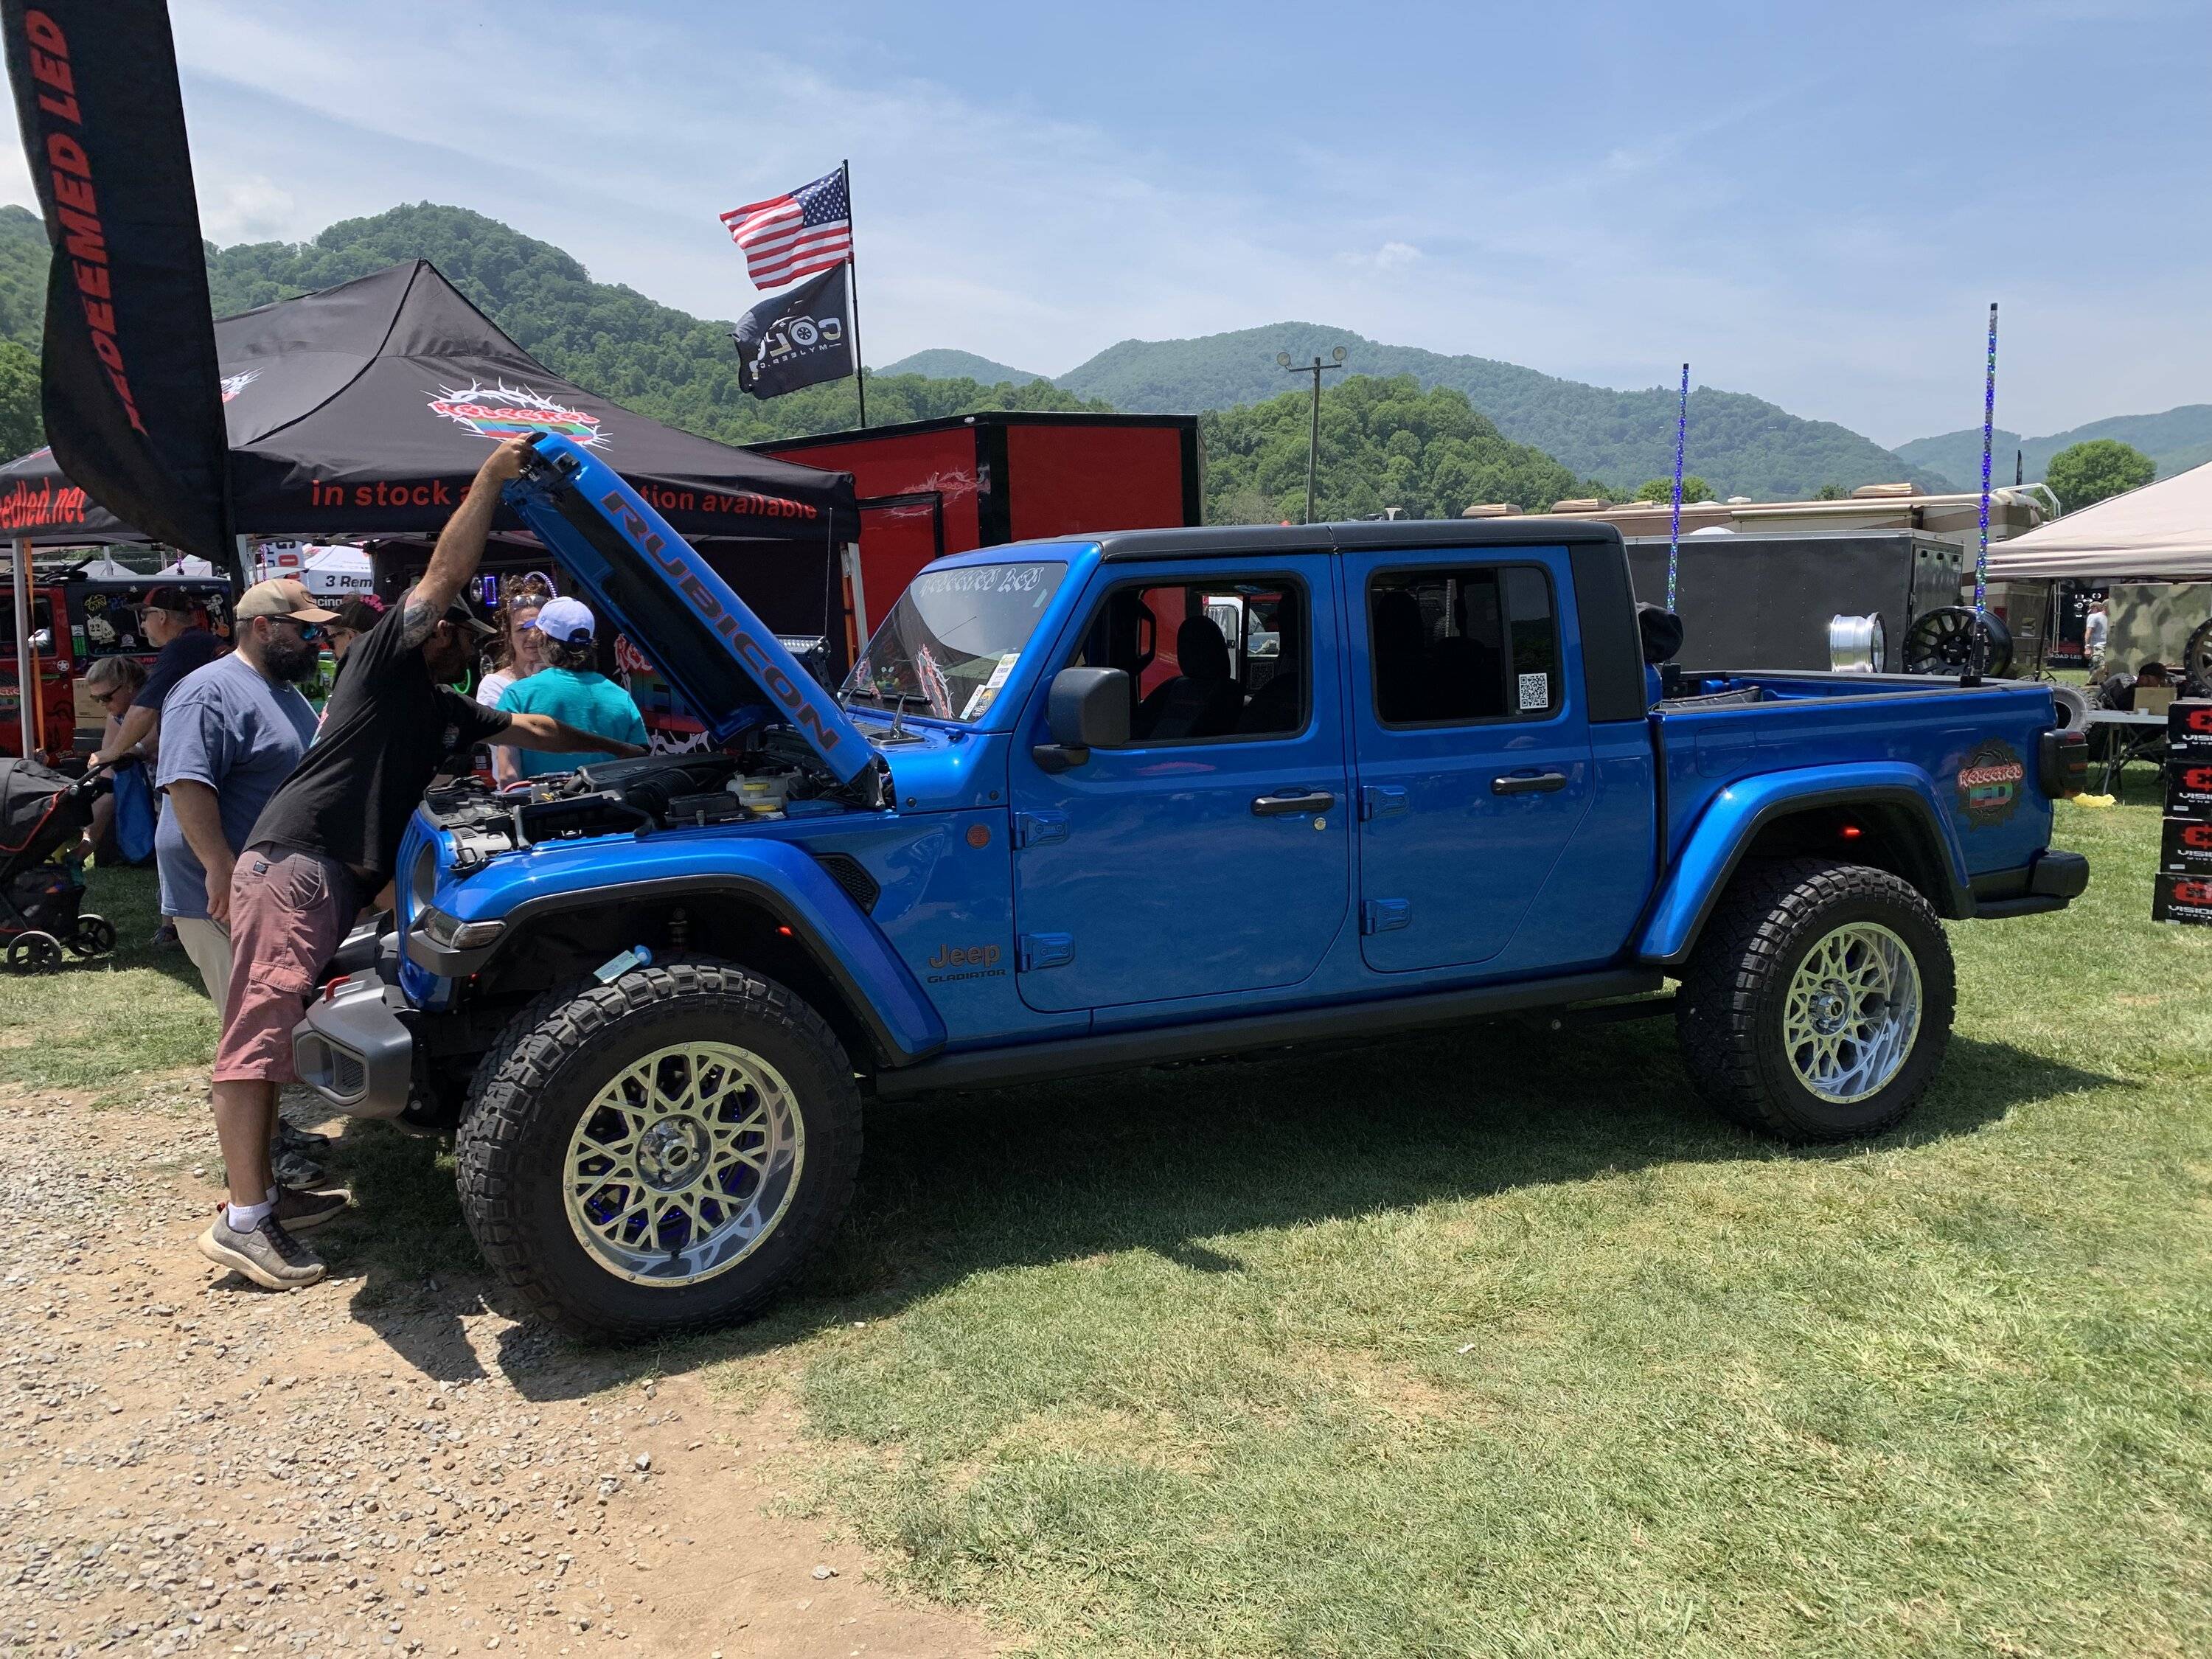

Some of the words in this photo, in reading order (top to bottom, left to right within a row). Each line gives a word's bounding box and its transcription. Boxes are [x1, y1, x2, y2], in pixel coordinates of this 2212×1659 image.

[27, 9, 83, 125] LED
[0, 476, 87, 529] edled.net
[312, 479, 344, 506] in
[355, 480, 451, 507] stock
[701, 493, 818, 519] available
[325, 575, 335, 588] 3
[601, 489, 841, 752] RUBICON
[2168, 905, 2212, 915] VISIO
[928, 943, 1001, 969] Jeep
[927, 969, 1006, 984] GLADIATOR
